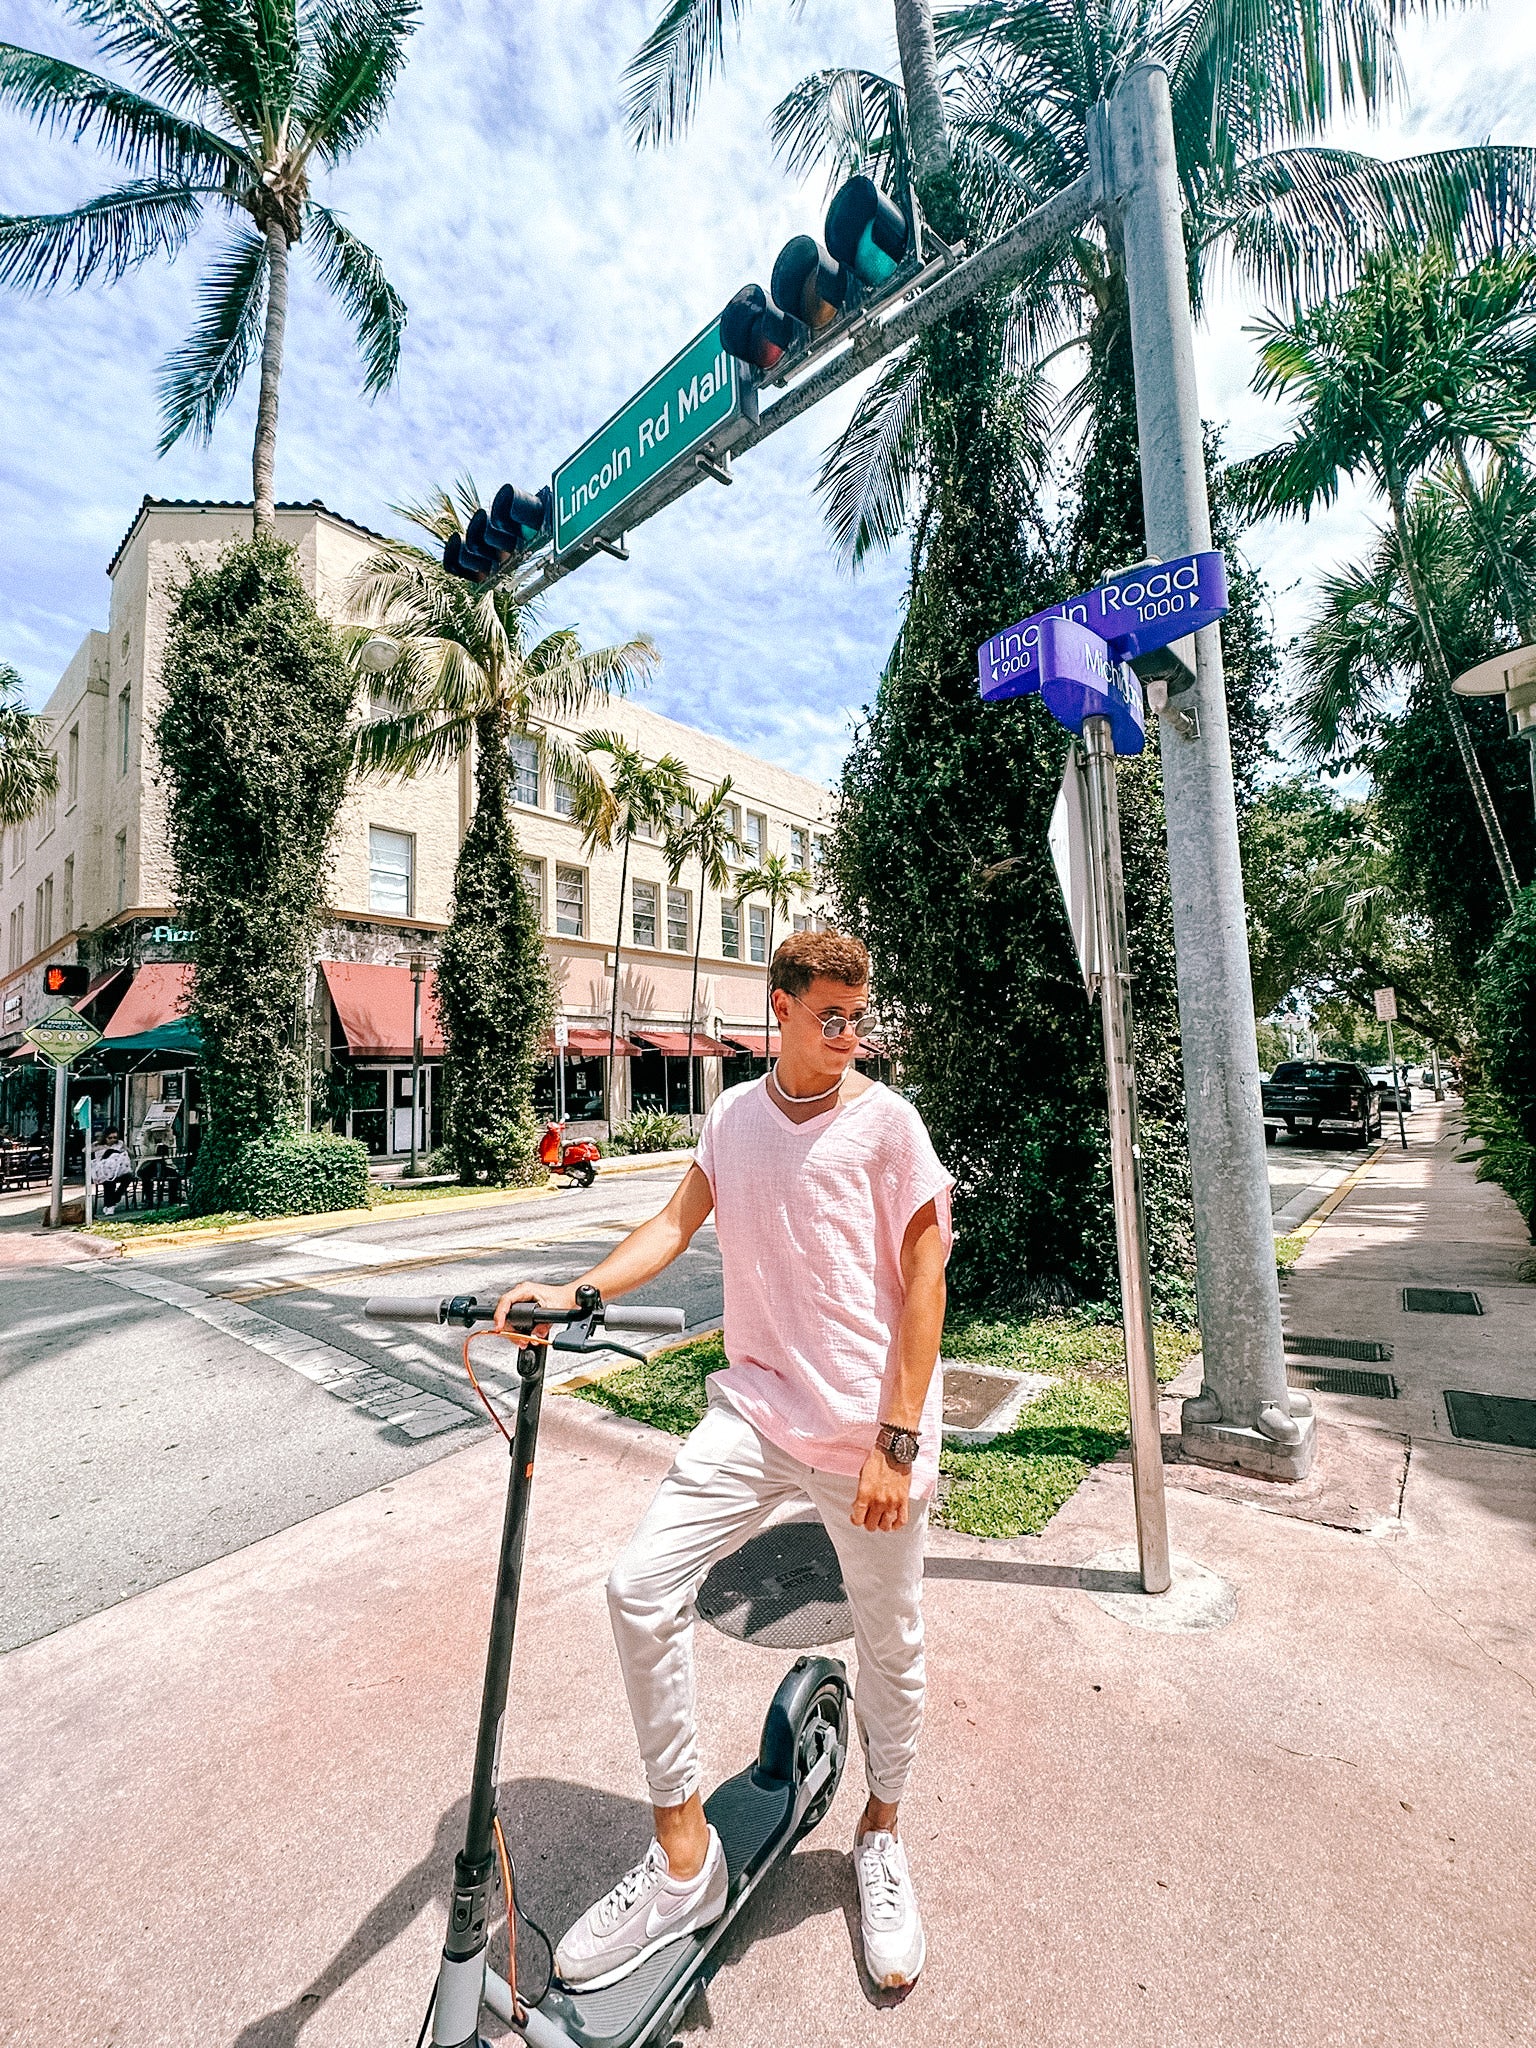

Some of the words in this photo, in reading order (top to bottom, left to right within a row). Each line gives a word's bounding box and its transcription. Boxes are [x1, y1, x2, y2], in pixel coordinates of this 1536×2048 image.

[559, 445, 632, 527] Lincoln
[638, 401, 670, 458] Rd
[677, 349, 728, 424] Mall
[988, 604, 1088, 666] Lincln
[1101, 559, 1200, 616] Road
[1136, 594, 1185, 622] 1000
[1001, 651, 1031, 677] 900
